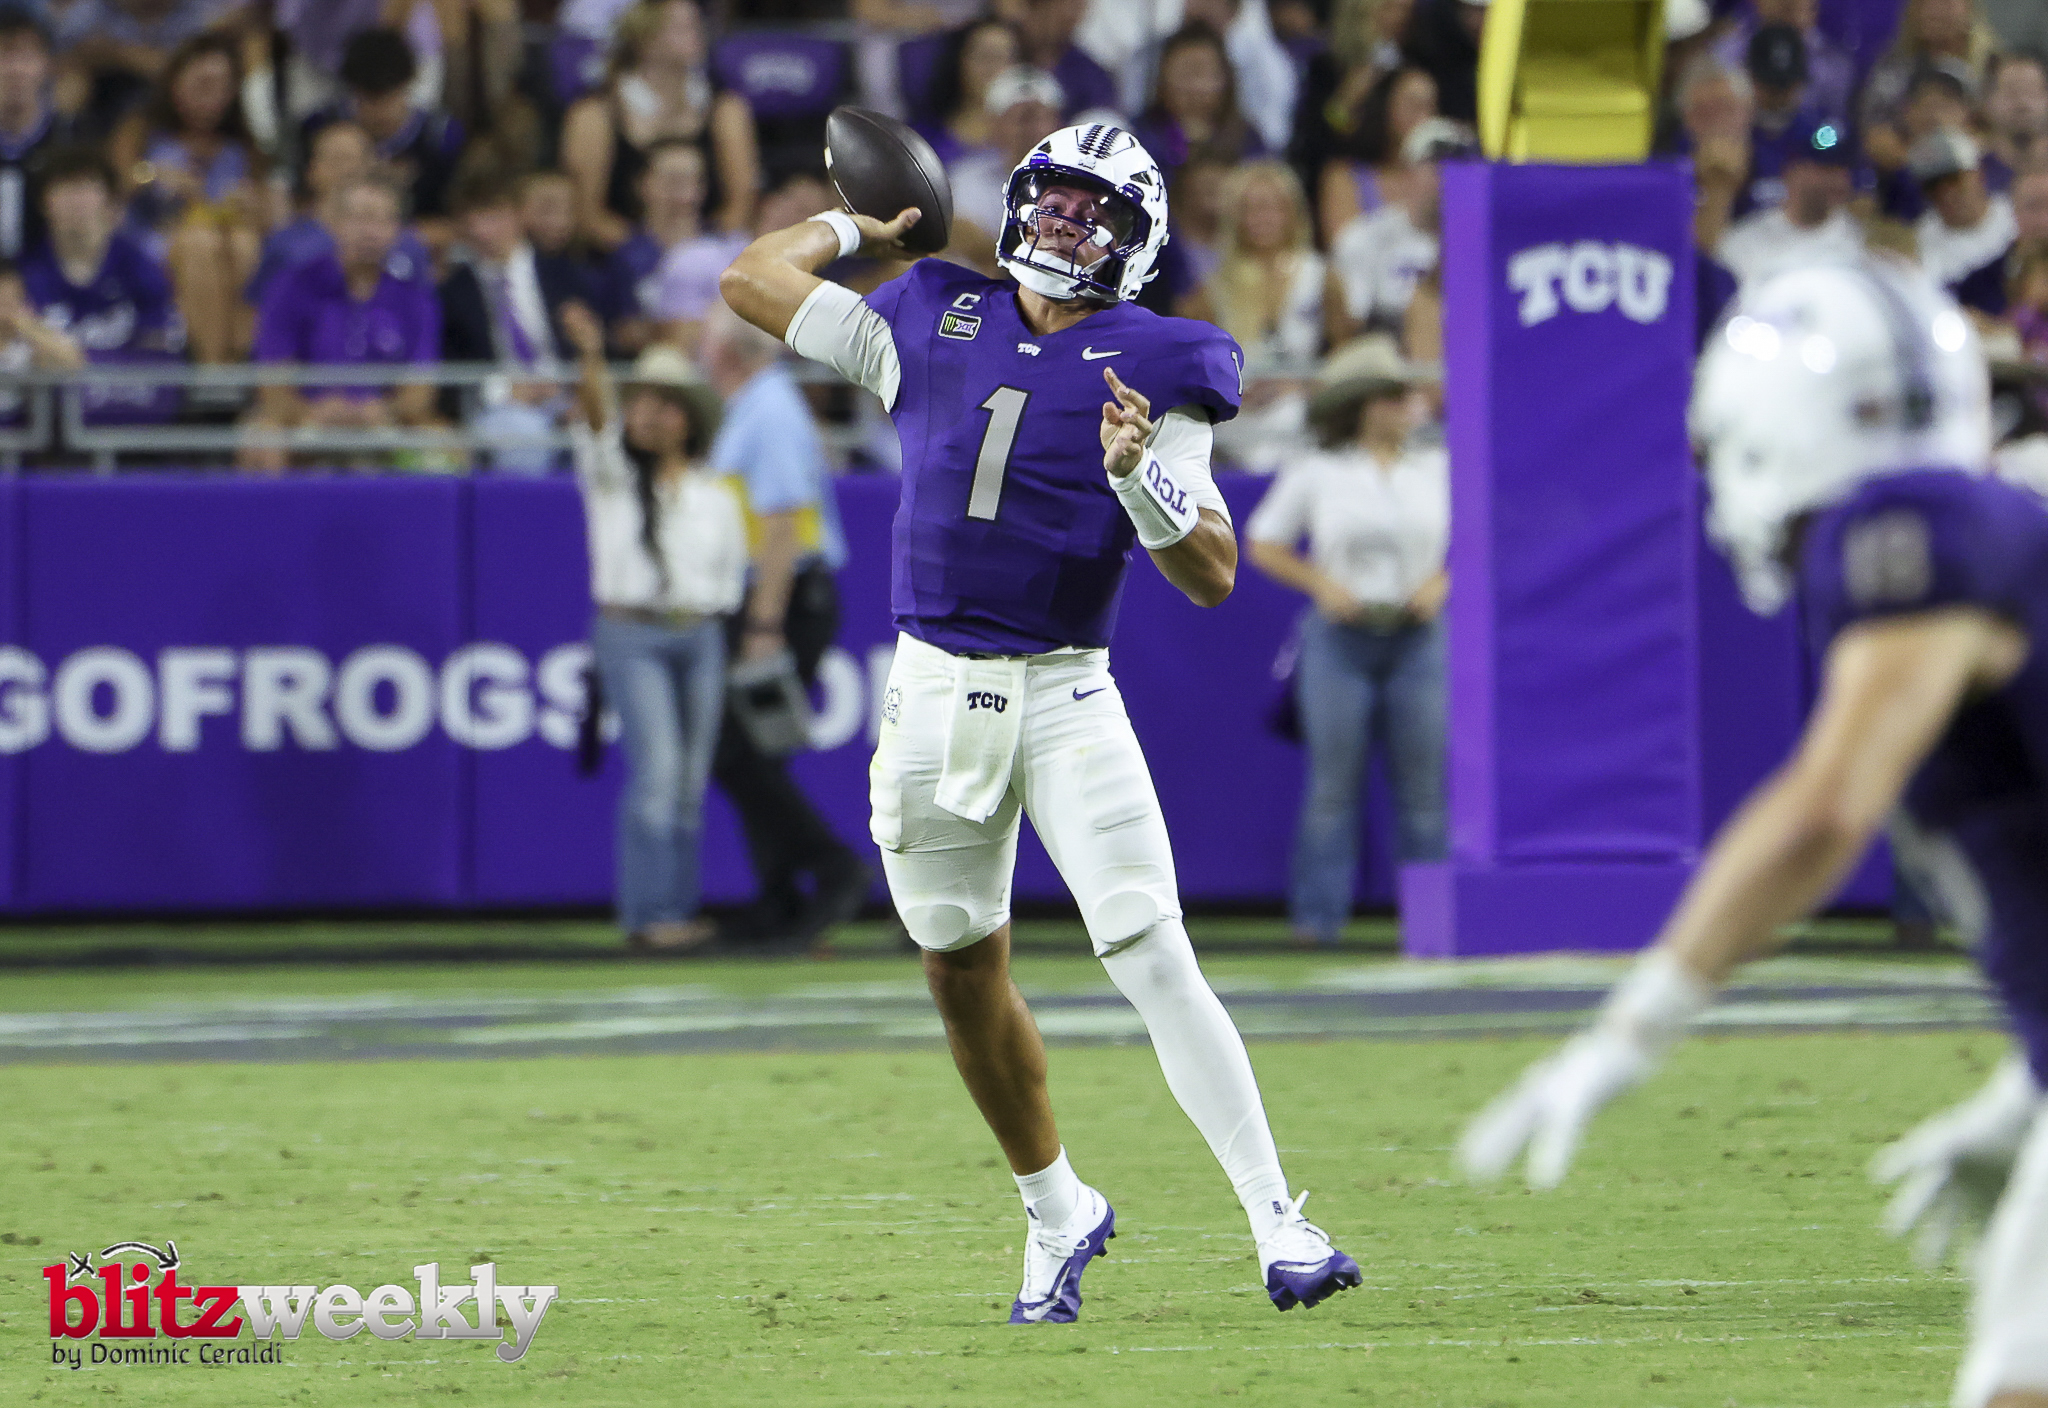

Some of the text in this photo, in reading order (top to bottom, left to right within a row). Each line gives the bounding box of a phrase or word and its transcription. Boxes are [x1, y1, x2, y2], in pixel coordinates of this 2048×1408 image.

[953, 293, 981, 310] C
[1507, 241, 1674, 327] TCU
[1017, 343, 1042, 357] TCU
[966, 384, 1031, 522] 1
[1147, 460, 1187, 516] TCU
[967, 692, 1008, 714] TCU
